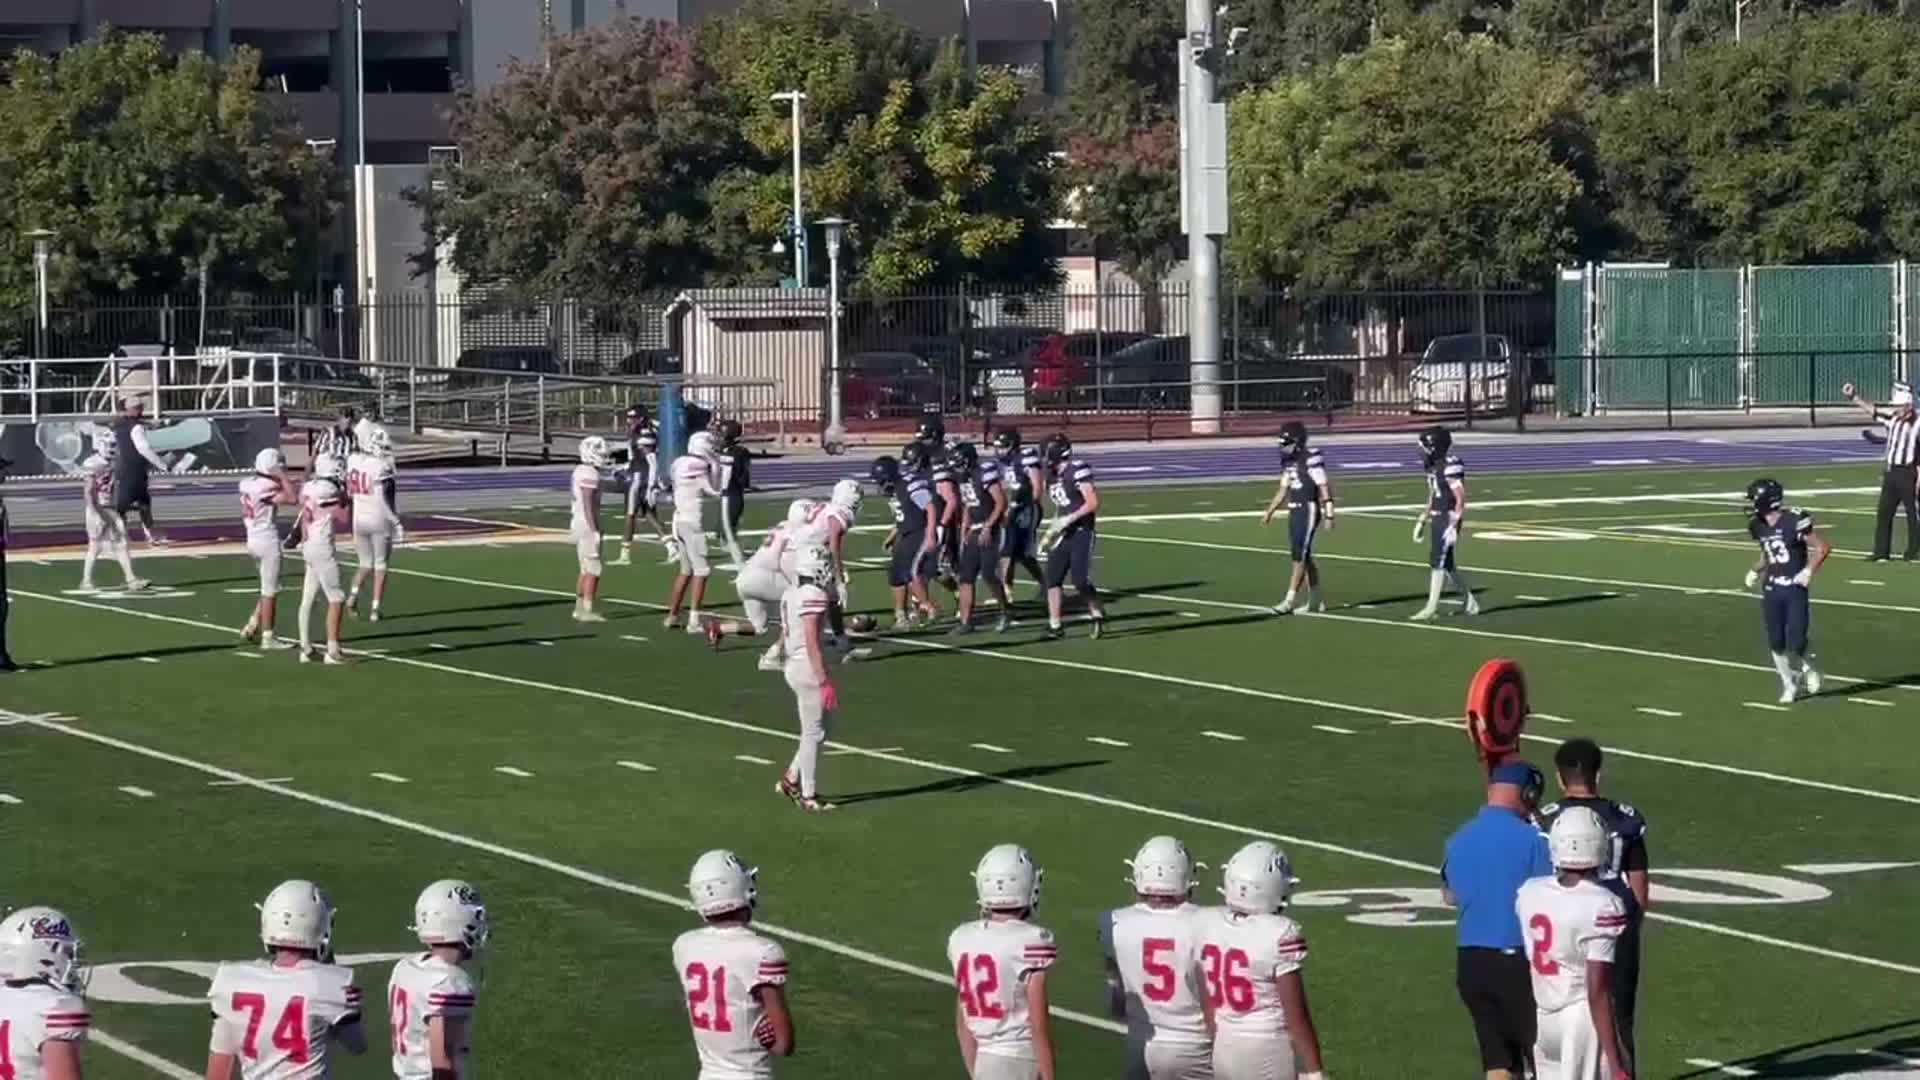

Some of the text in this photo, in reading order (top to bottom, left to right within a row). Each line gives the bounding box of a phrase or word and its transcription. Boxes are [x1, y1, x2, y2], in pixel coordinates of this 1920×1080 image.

[1764, 540, 1790, 564] 13
[1143, 938, 1175, 1002] 5
[1201, 944, 1255, 1012] 36
[1529, 914, 1559, 976] 2
[686, 962, 732, 1032] 21
[957, 952, 1004, 1020] 42
[232, 992, 309, 1063] 74
